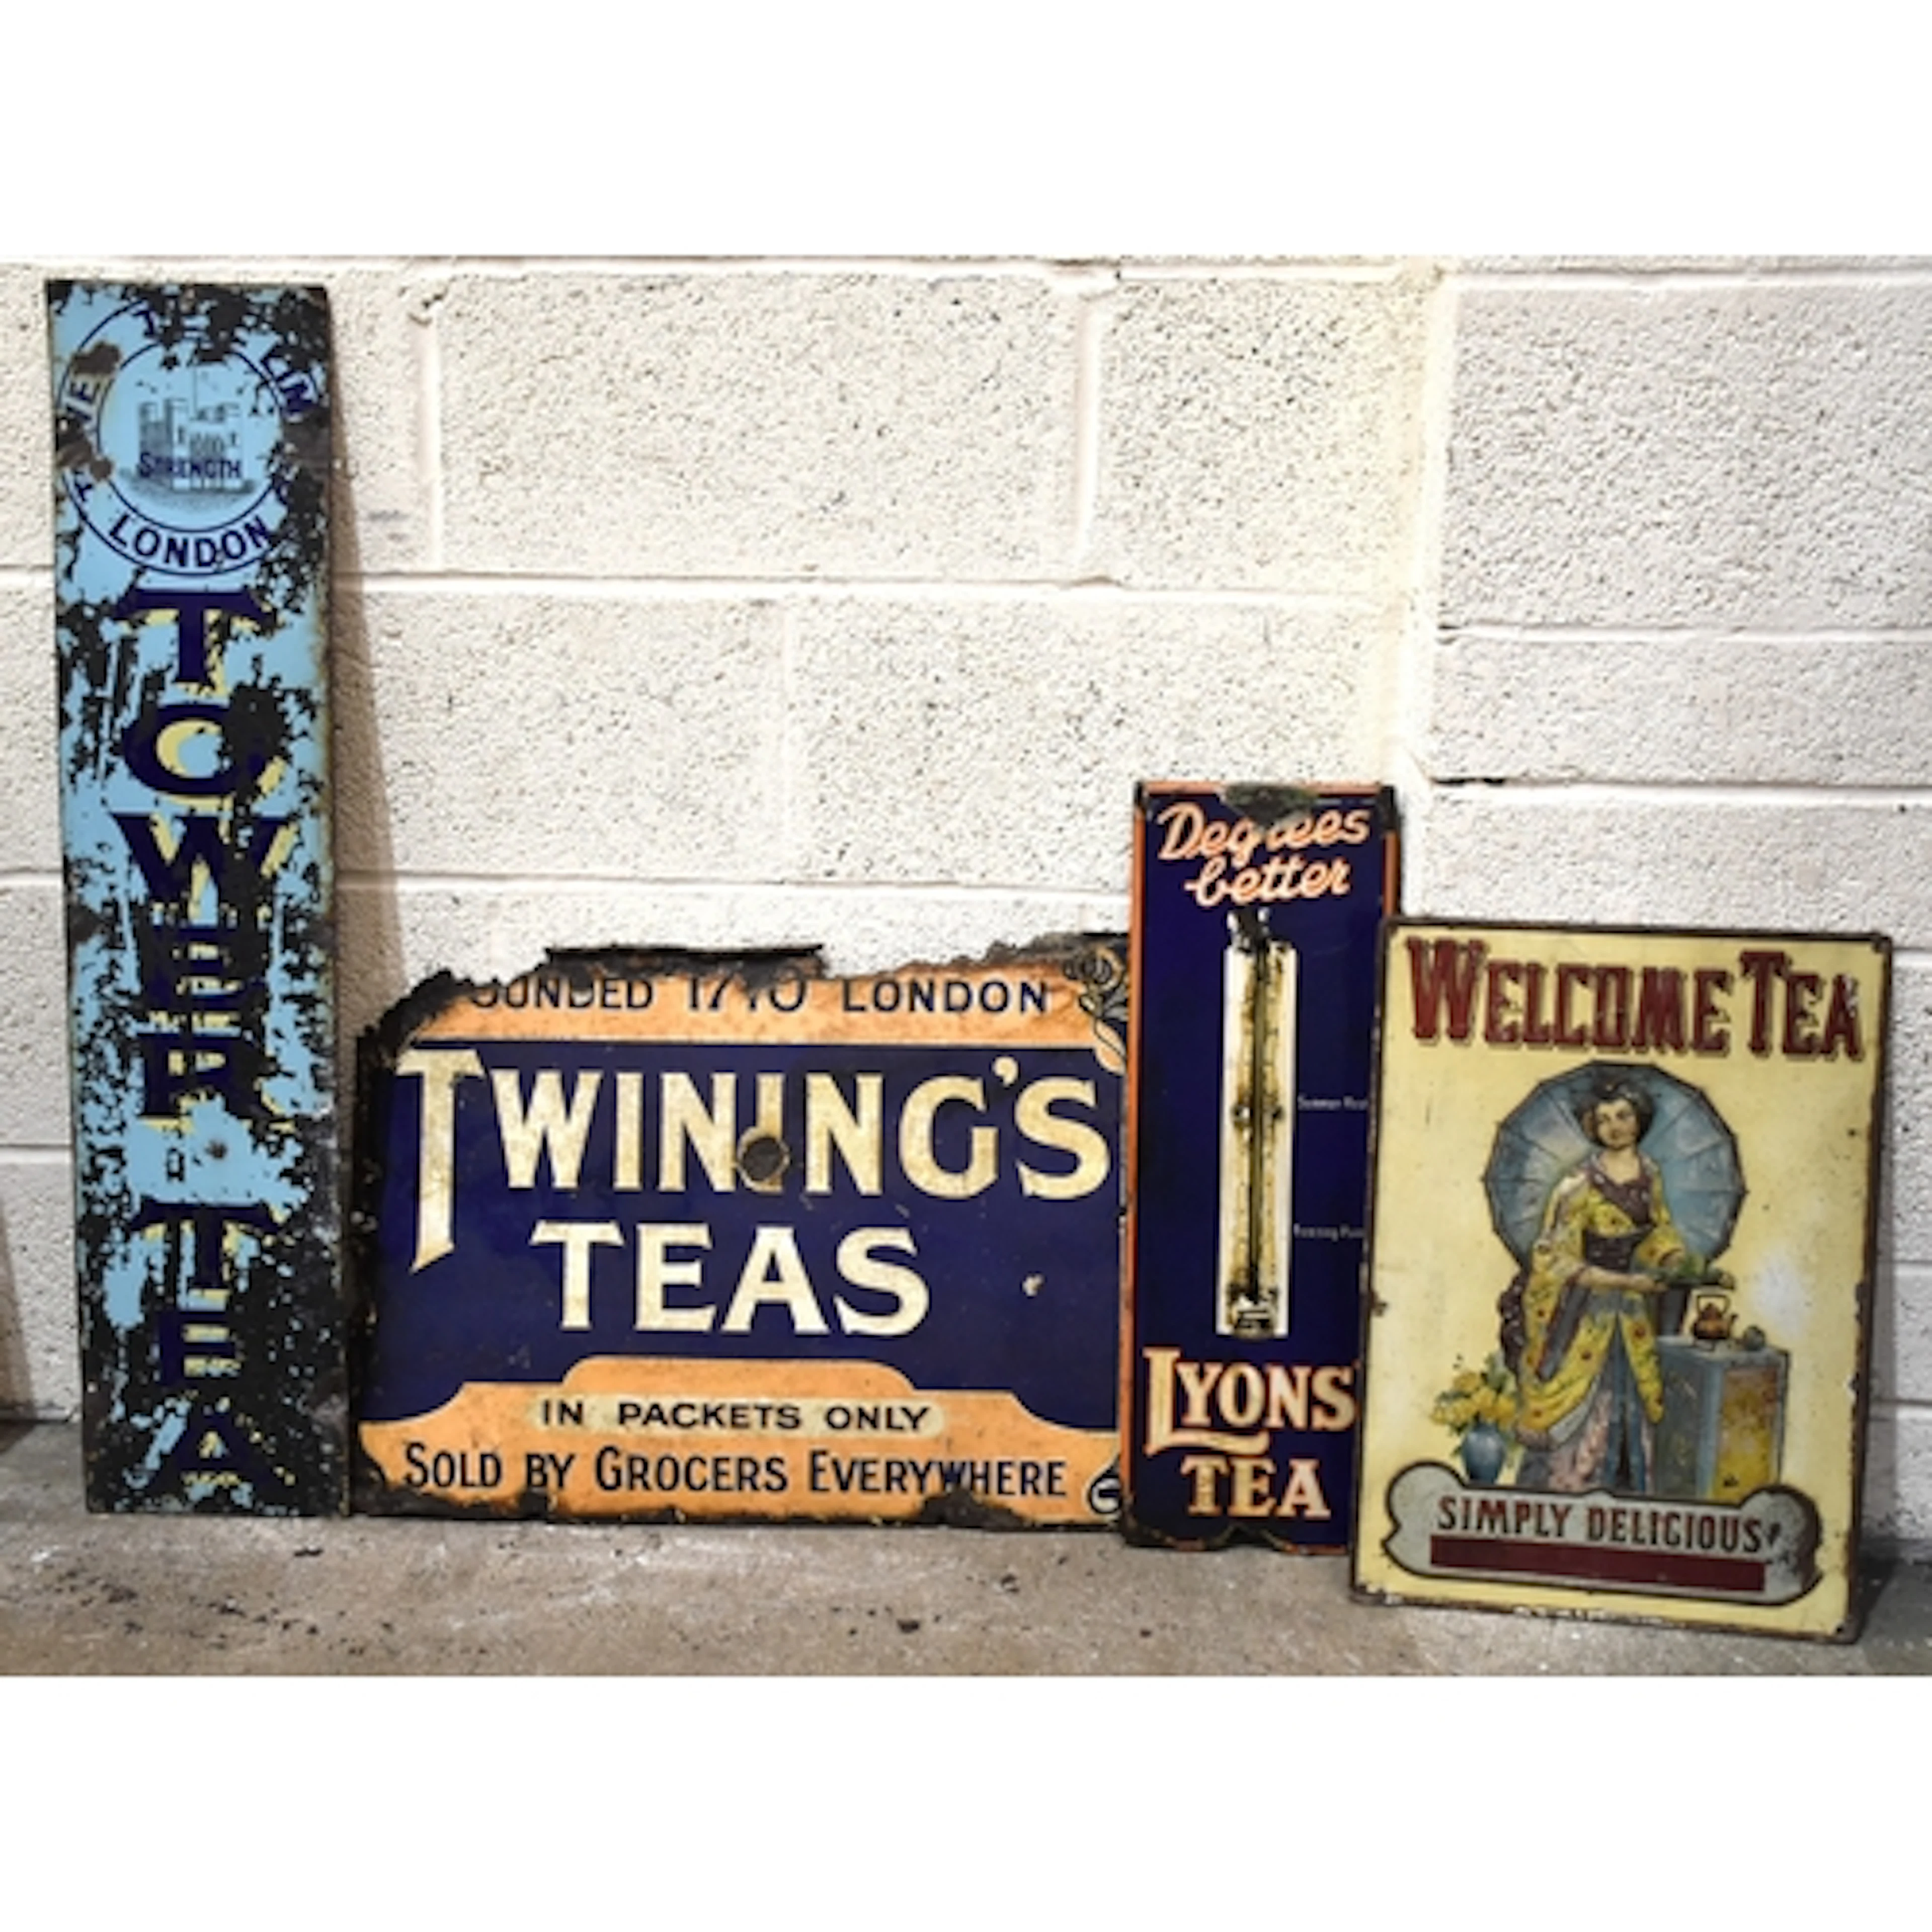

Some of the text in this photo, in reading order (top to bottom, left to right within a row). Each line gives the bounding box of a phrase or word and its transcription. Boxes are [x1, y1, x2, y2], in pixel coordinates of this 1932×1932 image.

[140, 452, 241, 478] STRENGTH
[108, 513, 276, 568] LONDON
[1183, 854, 1351, 907] better
[468, 975, 653, 1009] OUNDED
[841, 979, 1046, 1013] LONDON
[1407, 936, 1865, 1061] WELCOME TEA
[395, 1048, 1110, 1275] TWINING'S
[529, 1220, 930, 1335] TEAS
[542, 1400, 931, 1430] IN PACKETS ONLY
[405, 1442, 1067, 1496] SOLD BY GROCERS EVERYWHERE
[1180, 1457, 1331, 1518] TEA
[1437, 1495, 1762, 1553] SIMPLY DELICIOUS
